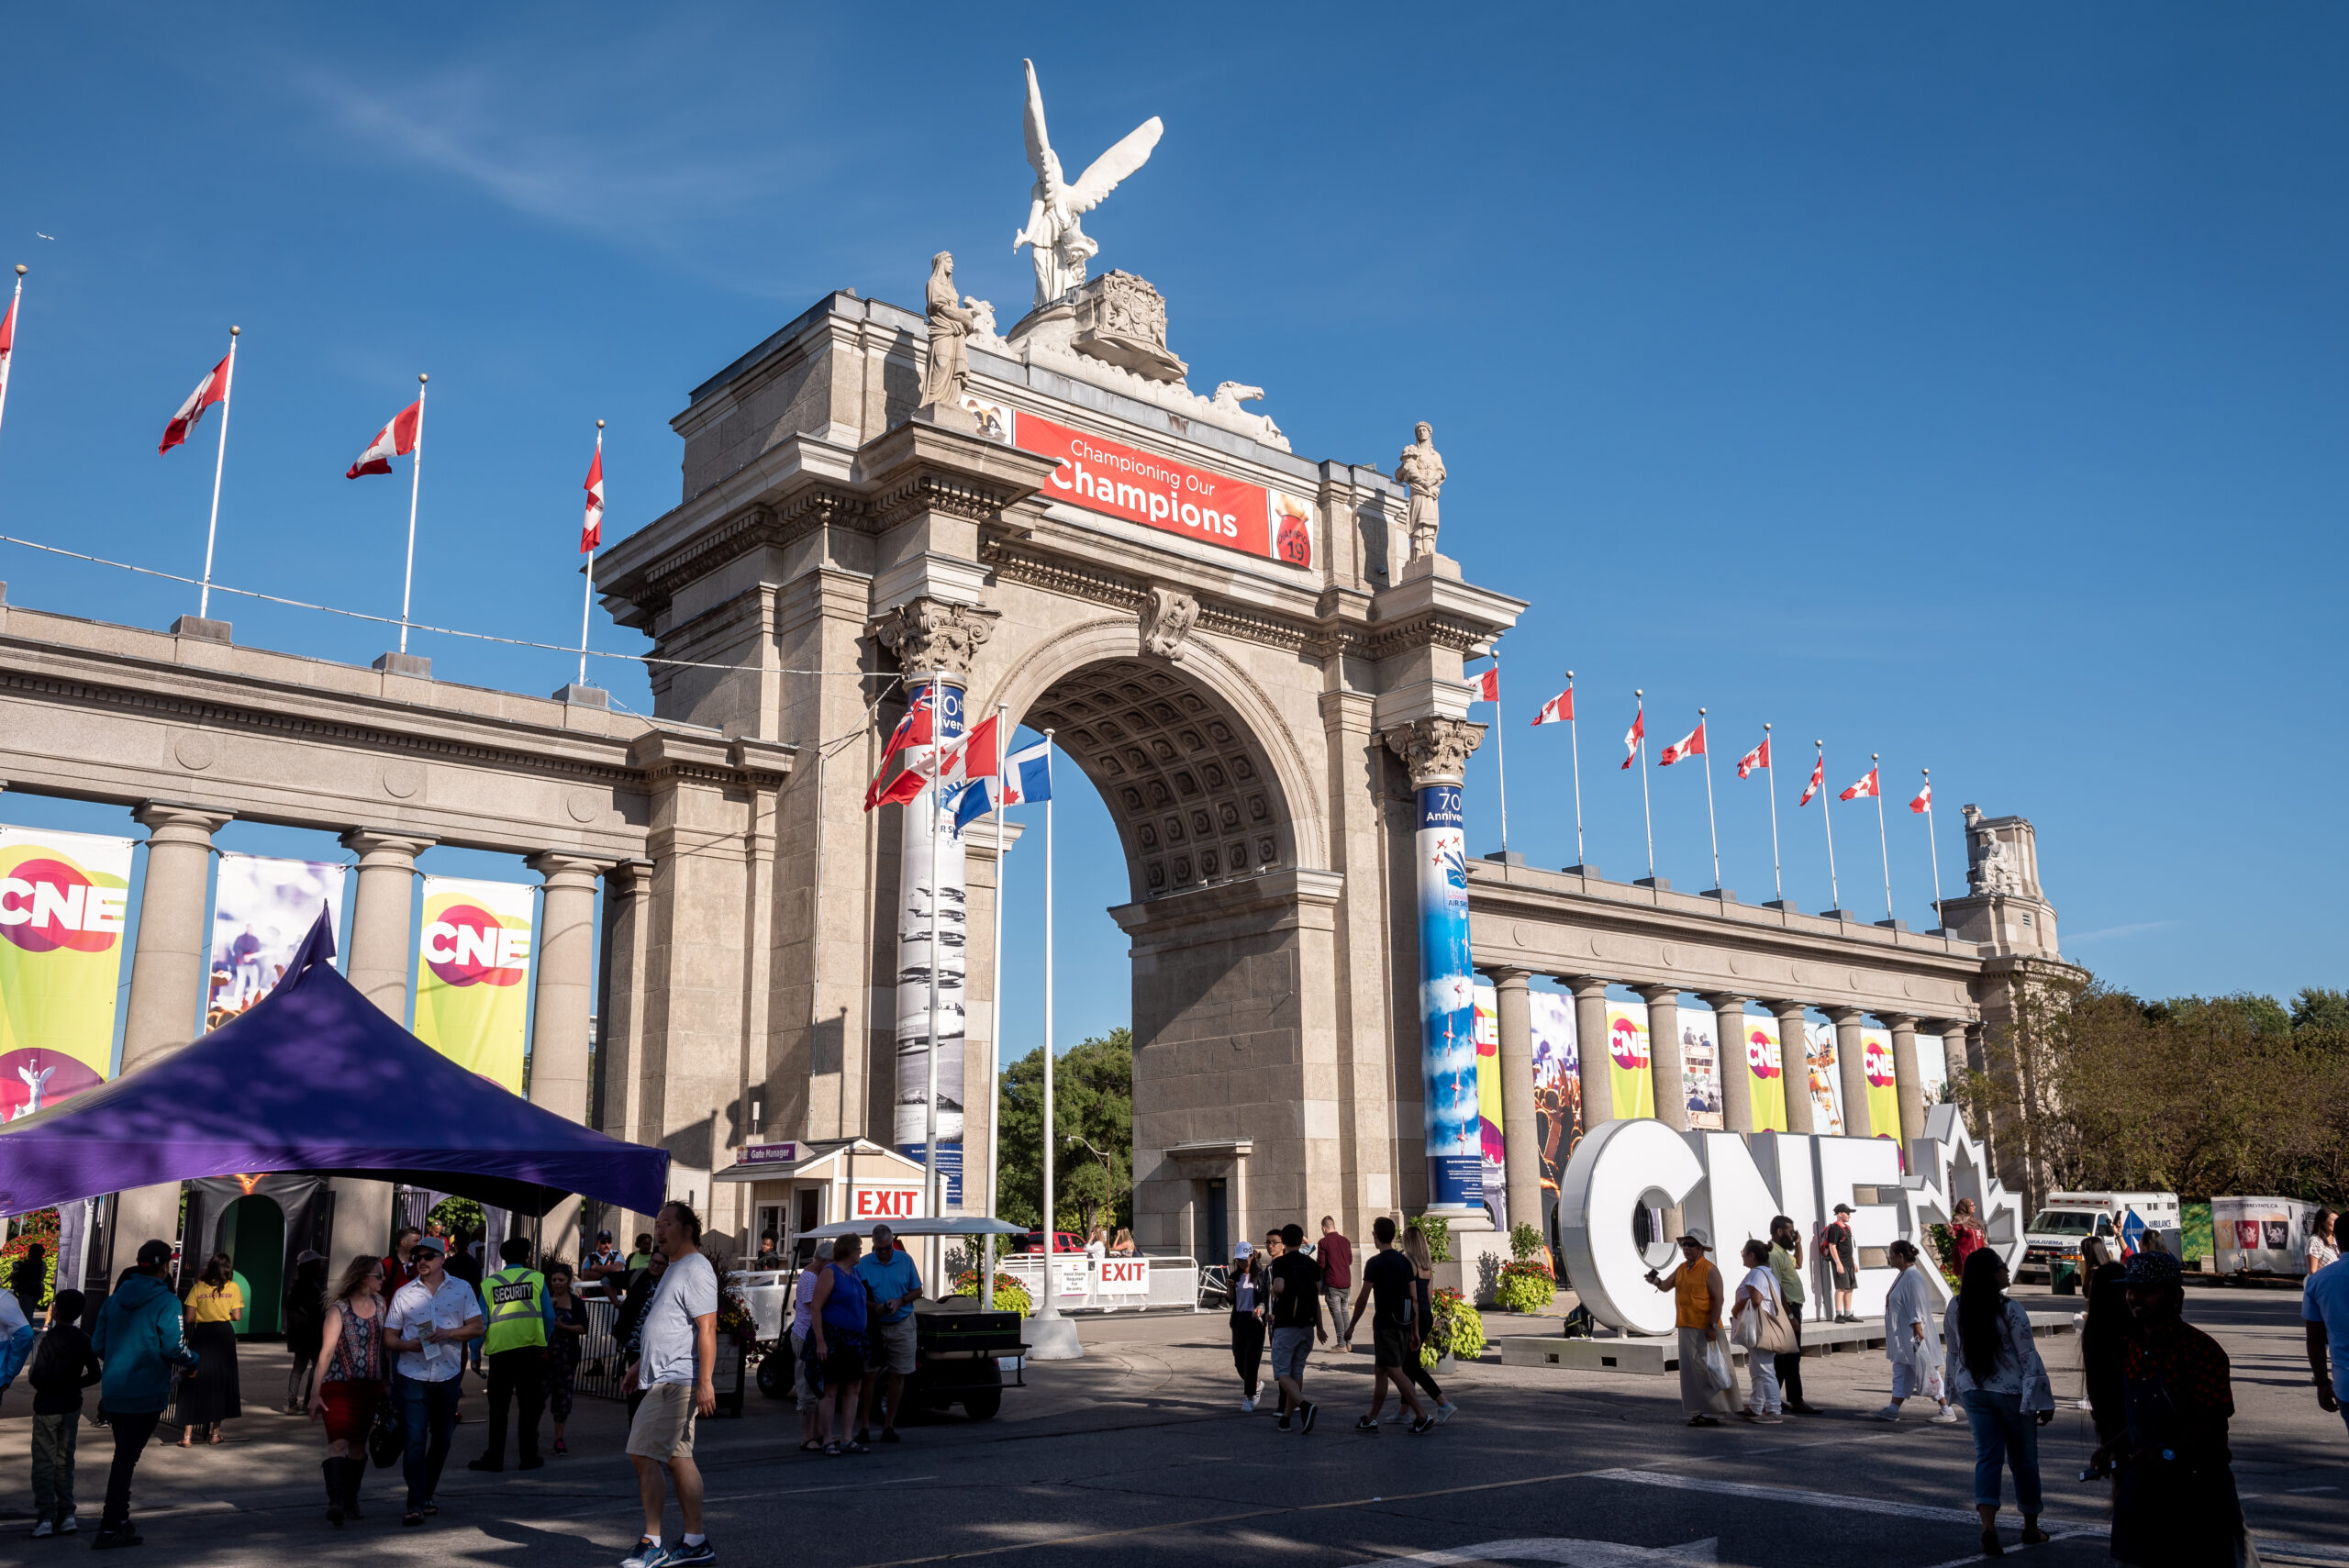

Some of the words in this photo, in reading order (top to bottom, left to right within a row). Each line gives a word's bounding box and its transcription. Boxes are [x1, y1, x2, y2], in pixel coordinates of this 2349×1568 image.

[1071, 439, 1180, 489] Championing
[1186, 474, 1216, 496] Our
[1050, 457, 1238, 538] Champions
[1287, 541, 1304, 561] 19
[1439, 793, 1461, 811] 70
[0, 877, 128, 933] CNE
[420, 921, 531, 969] CNE
[1608, 1029, 1651, 1058] CNE
[1746, 1040, 1783, 1068] CNE
[1863, 1051, 1895, 1077] CNE
[751, 1150, 764, 1160] Gate
[765, 1149, 789, 1159] Manager
[857, 1191, 918, 1215] EXIT
[1560, 1118, 1901, 1336] CNE
[2148, 1219, 2171, 1228] AMBULANCE
[1102, 1263, 1145, 1281] EXIT
[494, 1284, 532, 1302] SECURITY
